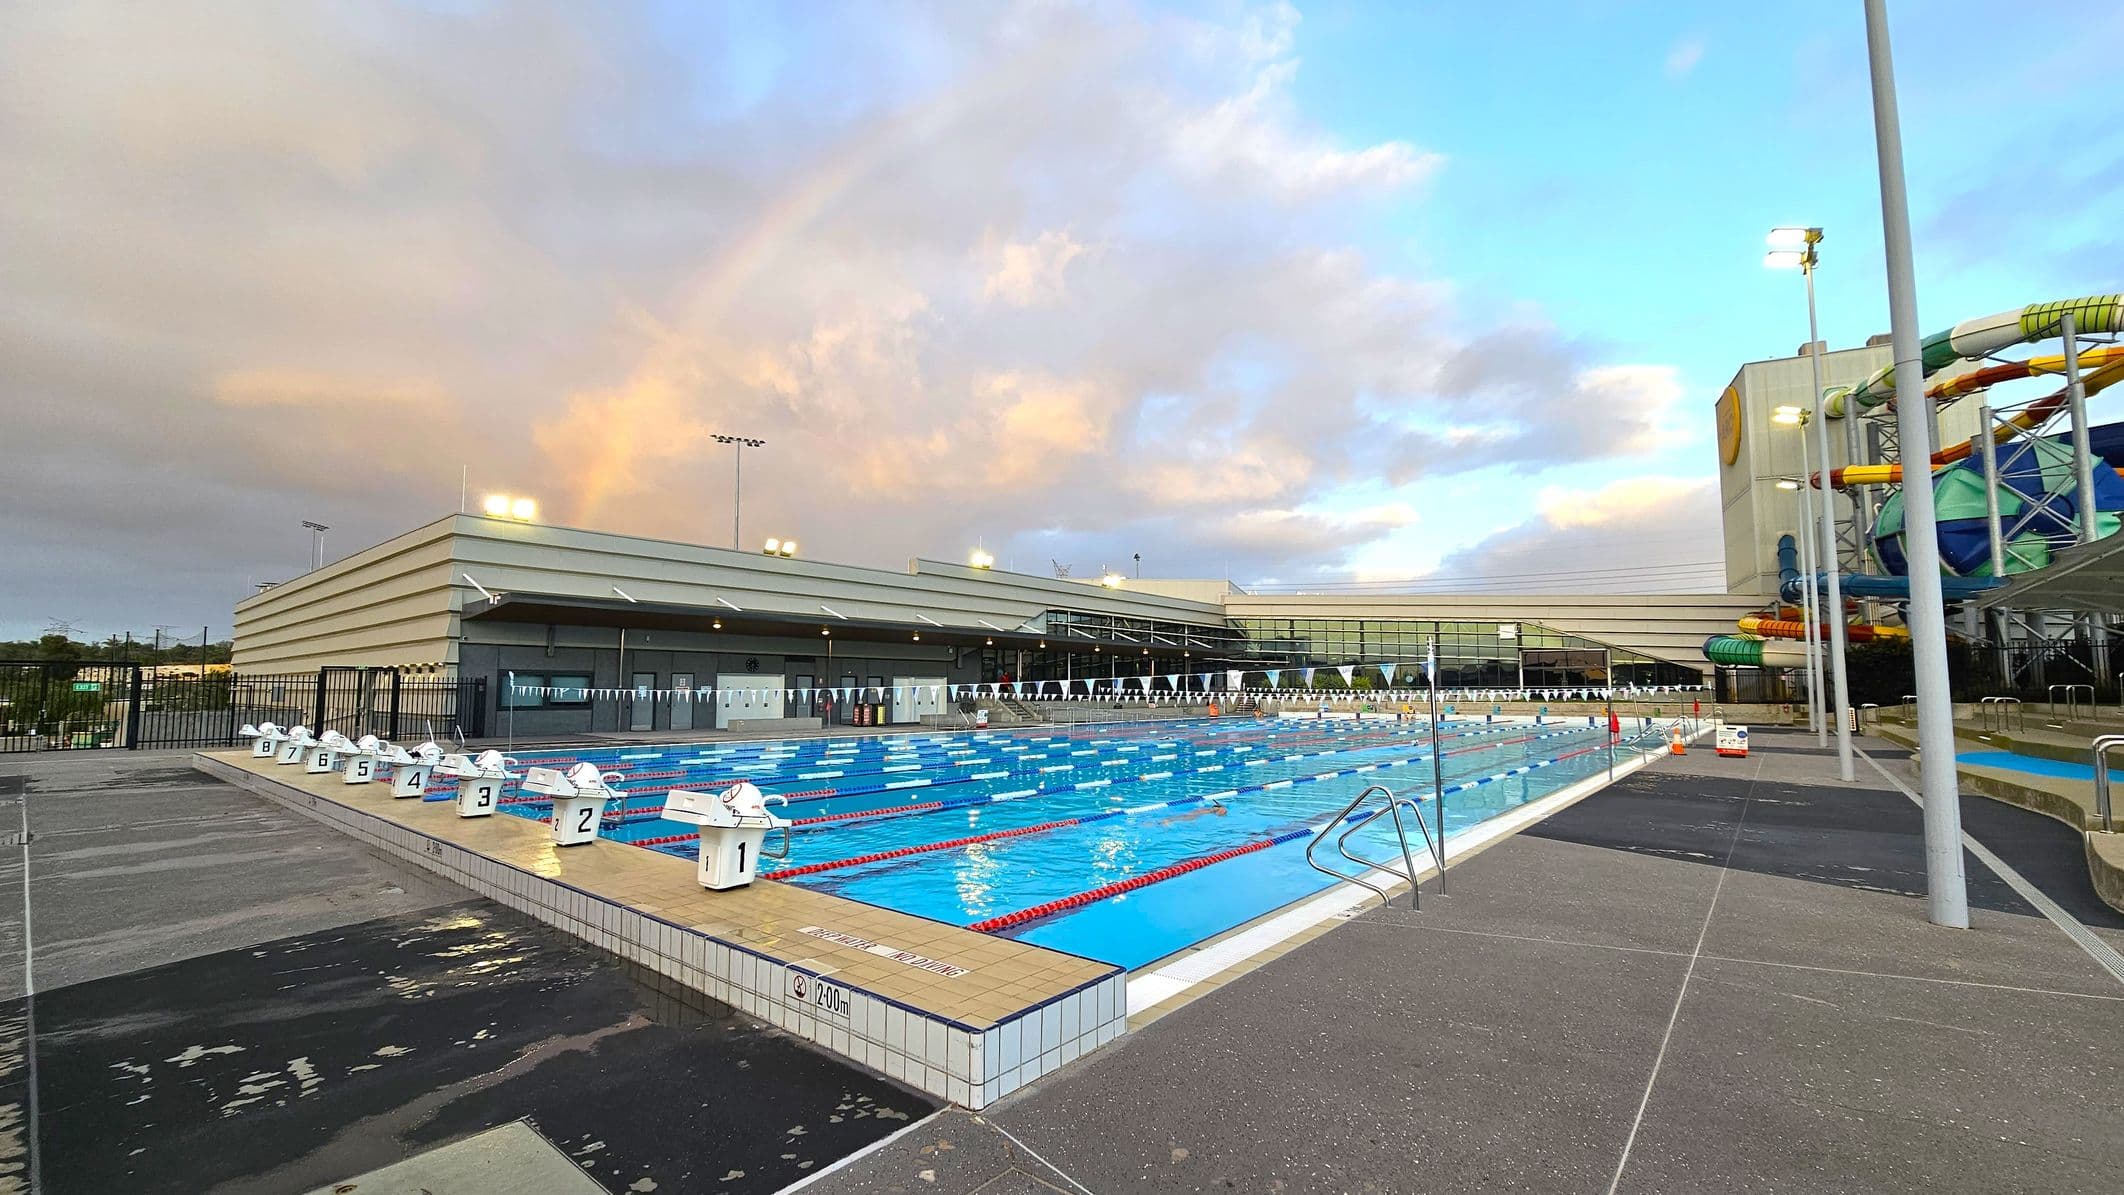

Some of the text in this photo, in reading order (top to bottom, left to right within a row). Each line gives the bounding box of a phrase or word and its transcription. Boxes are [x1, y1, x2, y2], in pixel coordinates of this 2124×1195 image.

[262, 741, 271, 753] 8
[287, 747, 297, 759] 7
[318, 753, 329, 767] 6
[357, 761, 369, 777] 5
[407, 771, 421, 789] 4
[477, 786, 491, 807] 3
[554, 818, 560, 832] 2
[577, 807, 593, 833] 2
[738, 842, 746, 873] 1
[806, 928, 877, 950] DEEP WATER
[888, 951, 965, 977] NO DIVING
